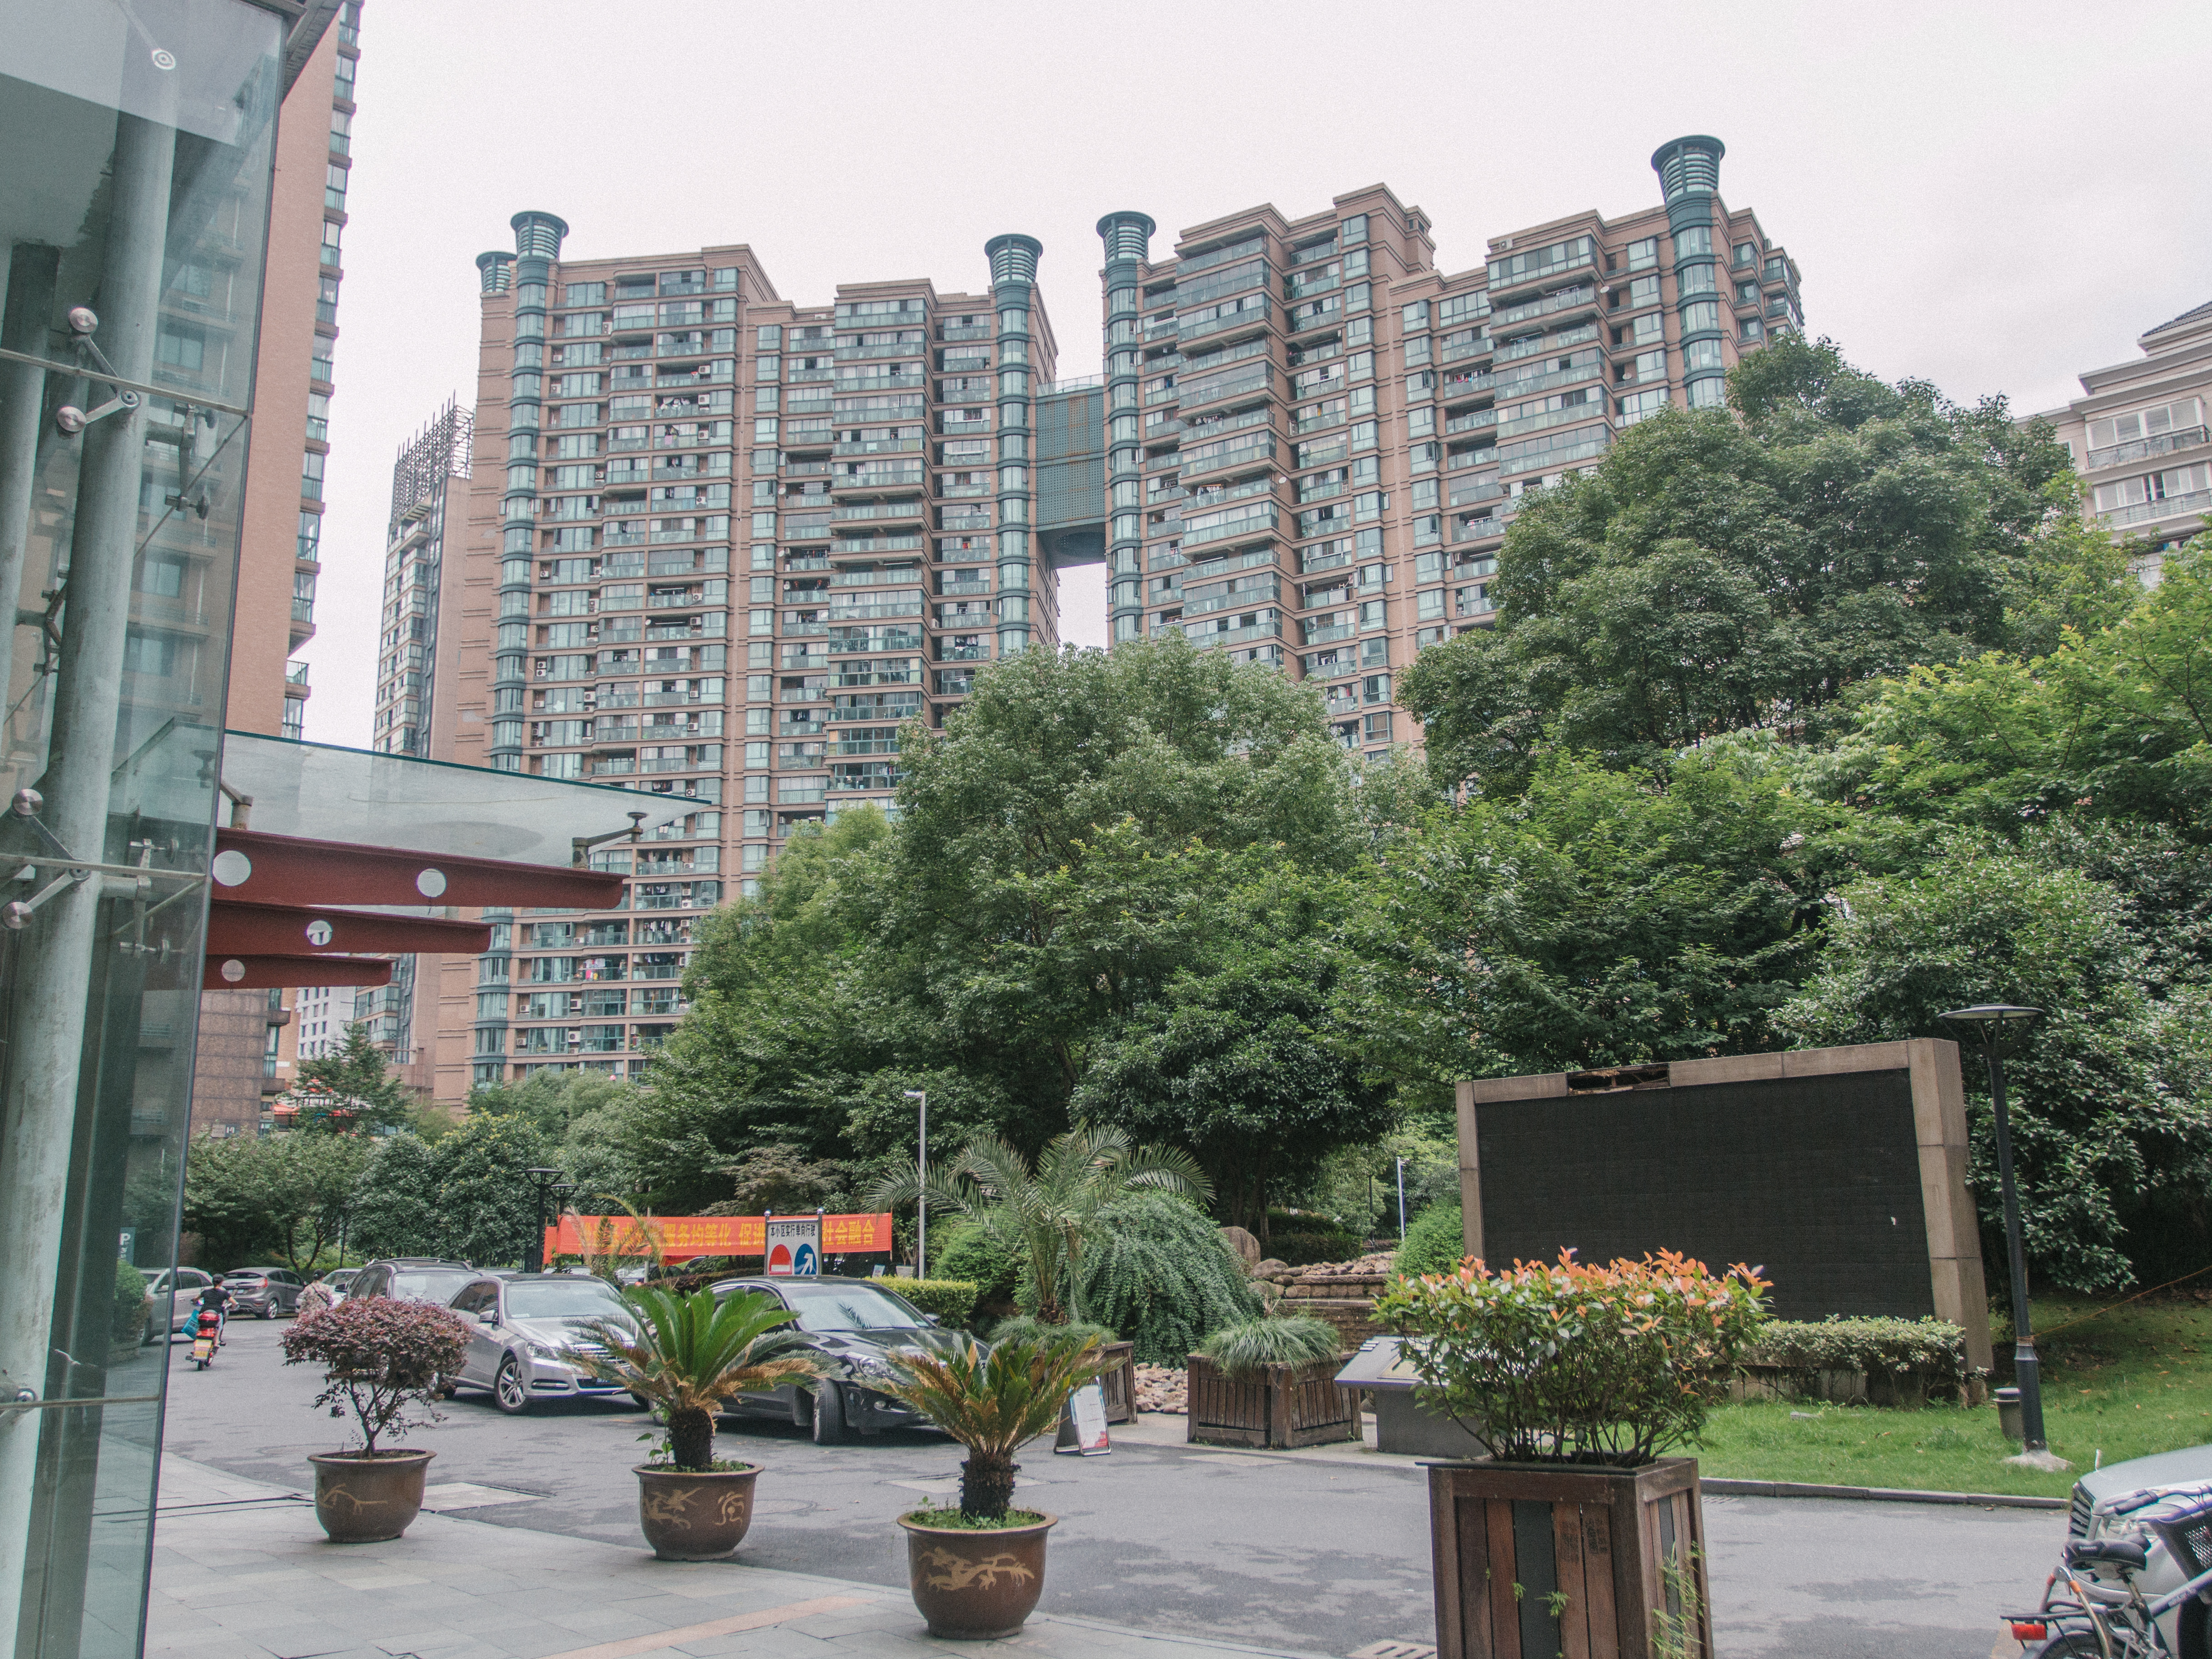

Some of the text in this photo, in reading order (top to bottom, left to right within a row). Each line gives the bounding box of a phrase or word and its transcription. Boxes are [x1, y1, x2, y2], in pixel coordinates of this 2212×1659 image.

[771, 1223, 815, 1237] 本小区实行单向行驶
[120, 1232, 131, 1246] P
